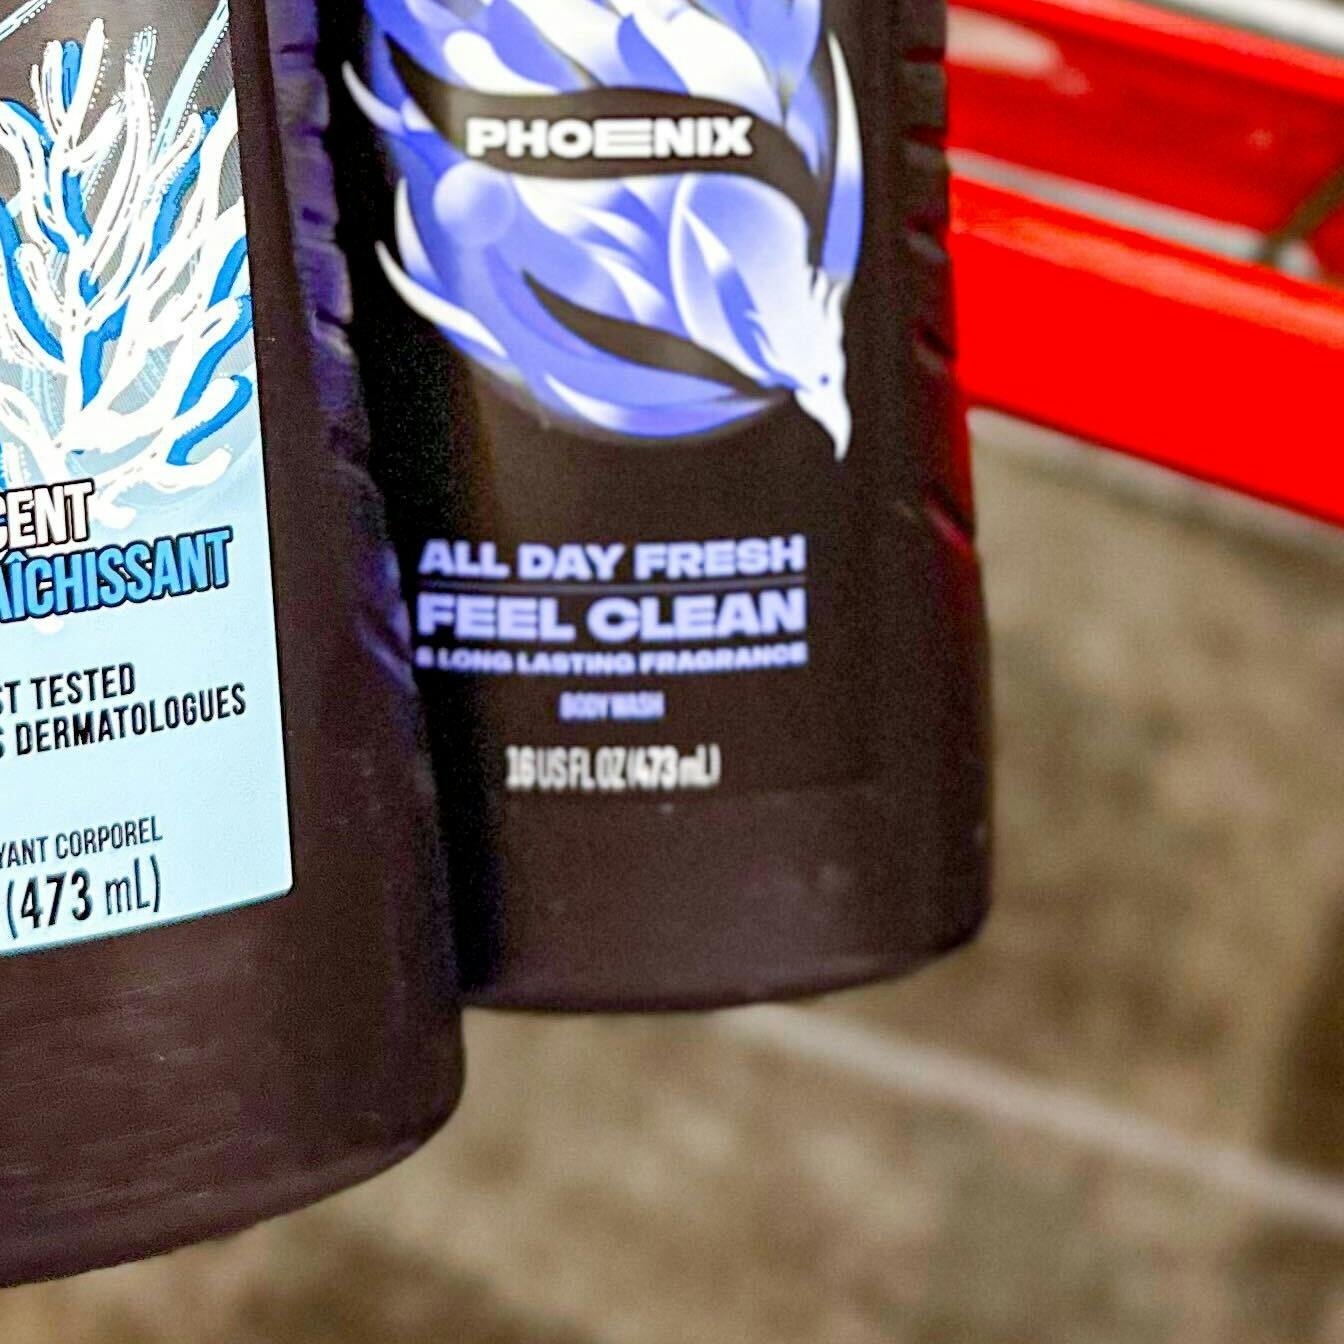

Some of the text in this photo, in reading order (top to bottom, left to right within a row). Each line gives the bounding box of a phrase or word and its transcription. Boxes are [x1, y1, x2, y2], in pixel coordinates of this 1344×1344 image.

[466, 117, 753, 158] PHOENIX
[418, 535, 807, 581] ALL DAY FRESH
[416, 587, 807, 643] FEEL CLEAN
[438, 649, 514, 673] LONG
[516, 651, 637, 676] LASTING
[640, 641, 809, 674] FRAGRANCE
[30, 661, 137, 711] TESTED
[15, 682, 248, 757] DERMATOLOGUES
[55, 815, 164, 860] CORPOREL
[6, 866, 94, 940] (473
[105, 854, 162, 916] mL)
